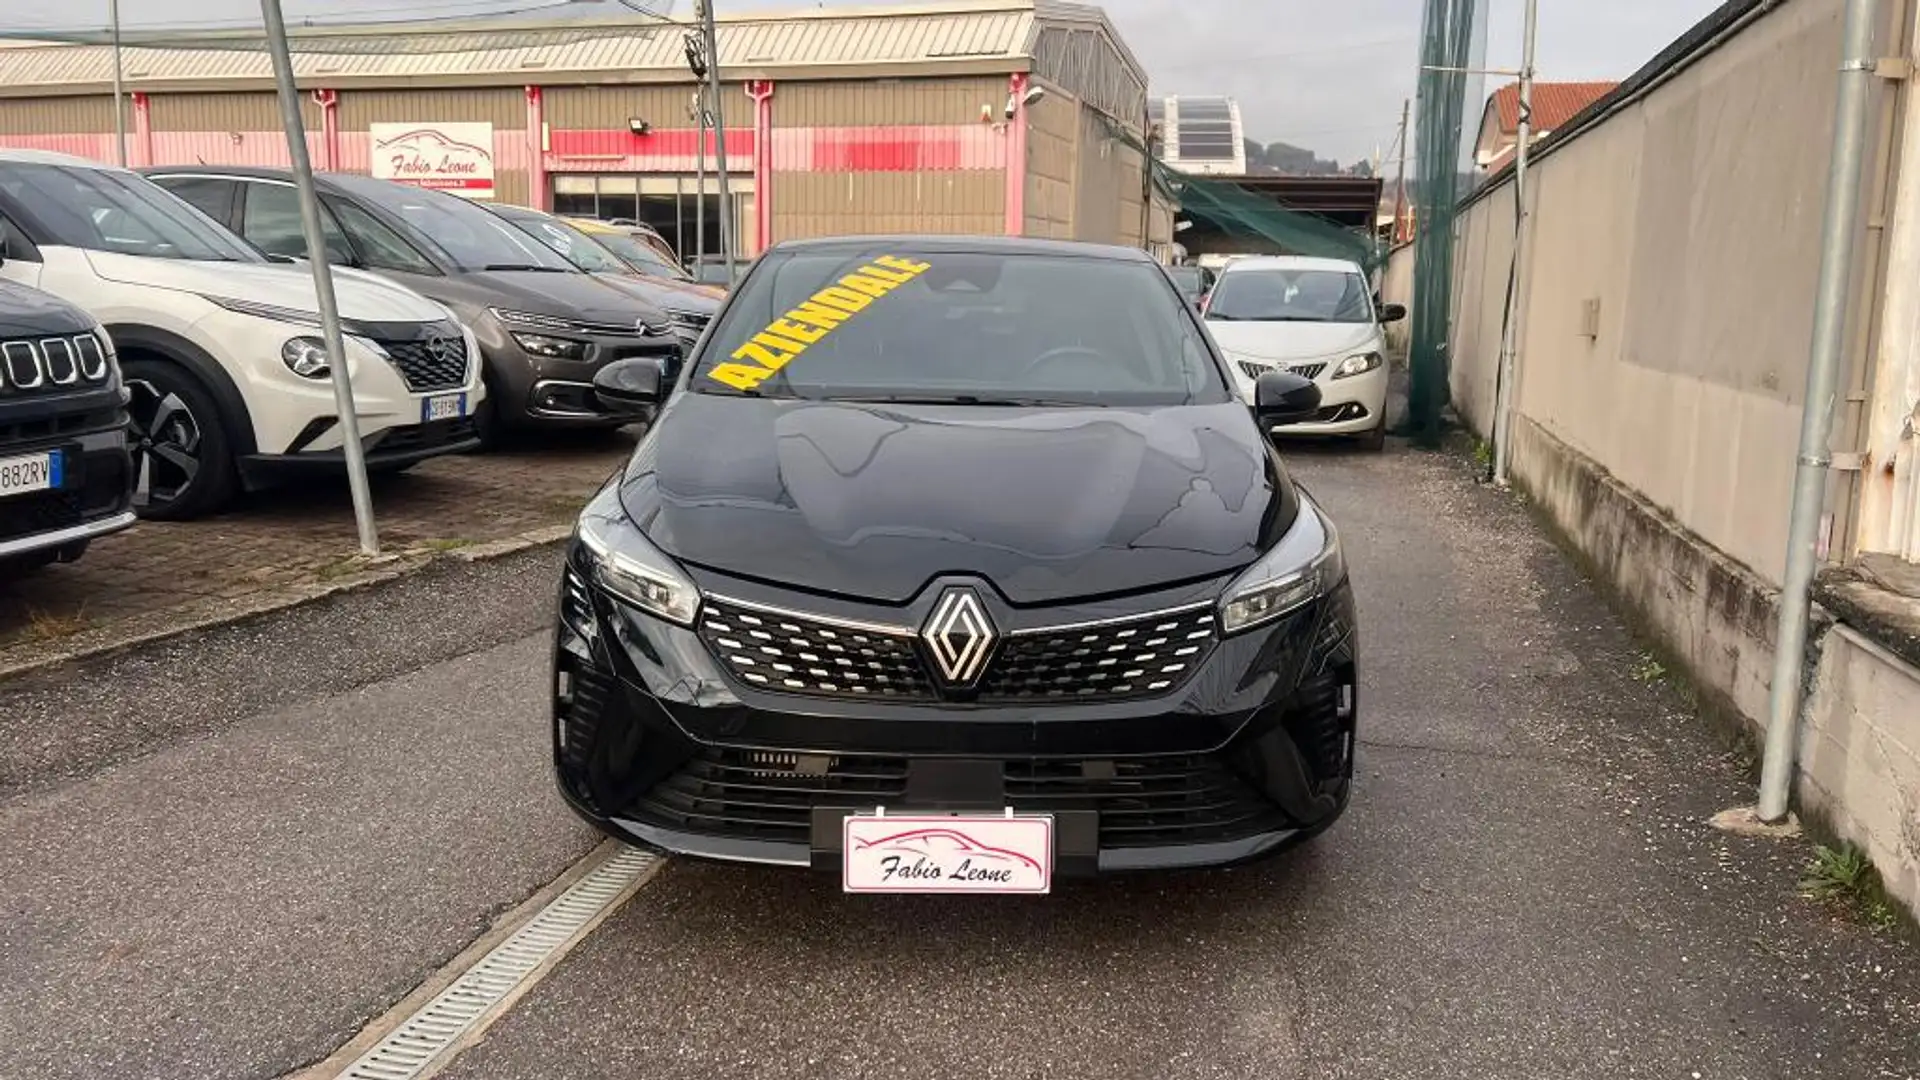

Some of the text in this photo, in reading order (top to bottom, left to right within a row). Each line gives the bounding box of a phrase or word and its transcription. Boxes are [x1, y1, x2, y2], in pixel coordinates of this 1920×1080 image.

[391, 154, 476, 176] Fabio Leone
[707, 255, 931, 390] AZIENDALE
[2, 460, 48, 488] 882RV
[881, 856, 1012, 883] Fabio Leone
